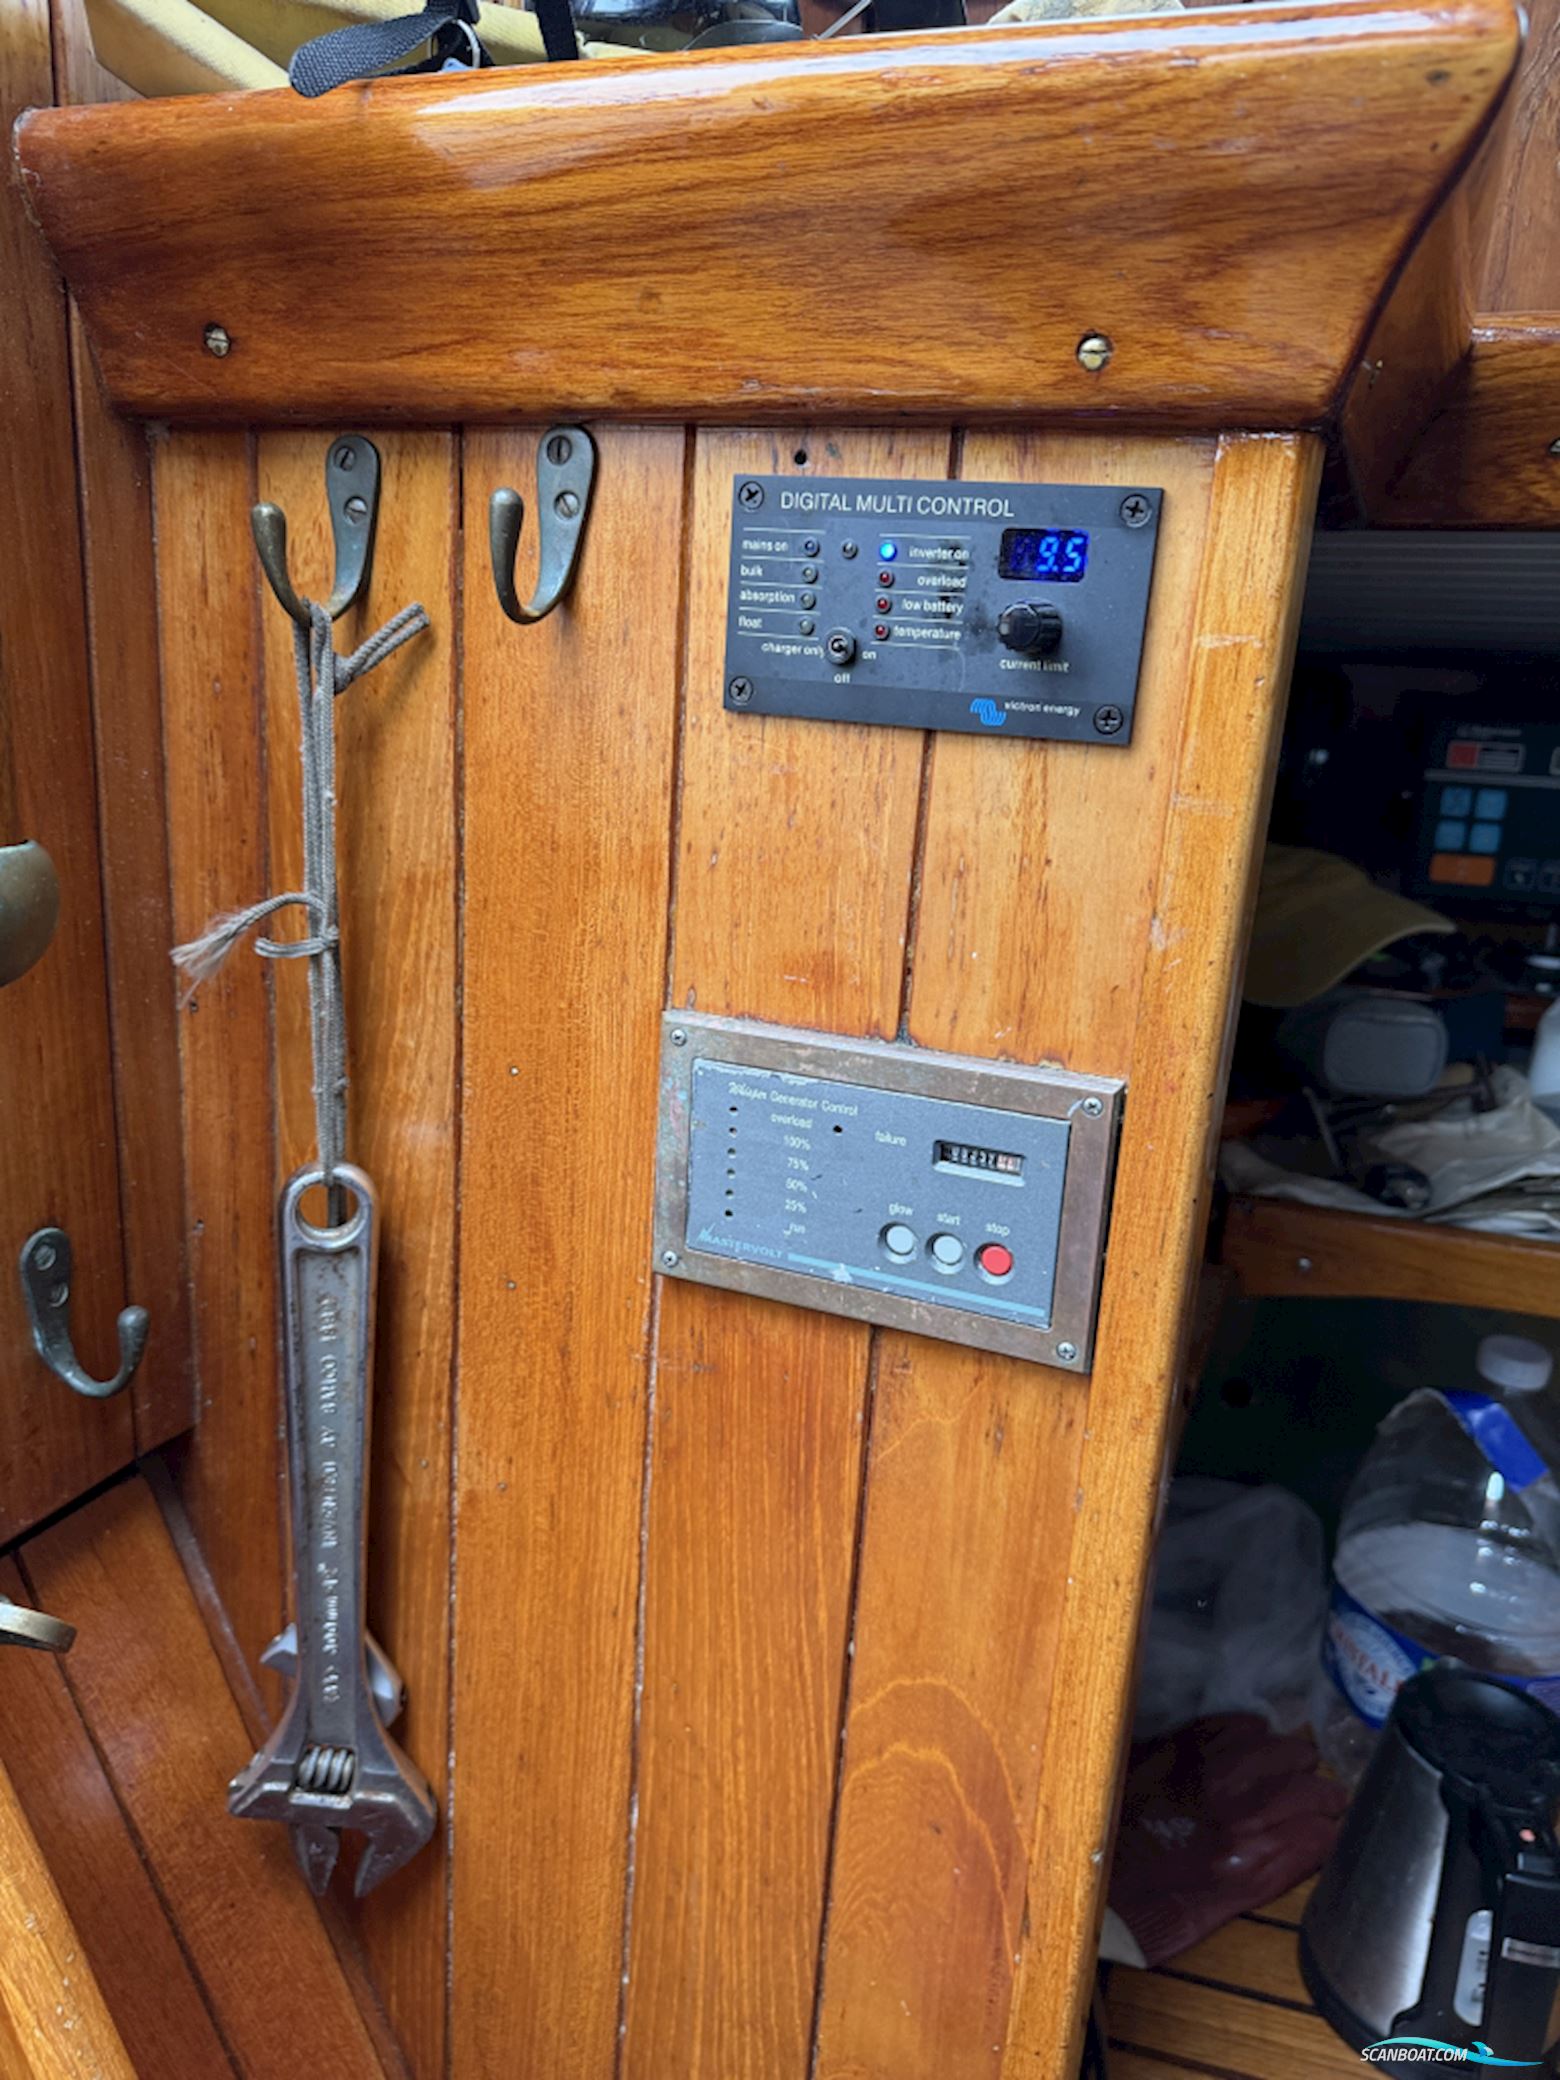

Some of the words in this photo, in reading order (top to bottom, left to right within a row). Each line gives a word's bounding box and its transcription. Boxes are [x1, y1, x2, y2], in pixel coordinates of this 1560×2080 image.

[780, 491, 852, 512] DIGITAL
[855, 495, 912, 513] MULTI
[916, 496, 1015, 518] CONTROL
[742, 540, 773, 552] mains
[774, 541, 789, 552] on
[908, 546, 953, 560] inverter
[953, 548, 970, 560] on
[740, 564, 763, 577] bulk
[916, 575, 967, 589] overload
[739, 588, 796, 604] absorption
[902, 598, 921, 611] low
[923, 599, 963, 616] battery
[738, 615, 763, 629] float
[893, 624, 962, 640] temperature
[760, 641, 802, 657] charger
[803, 644, 825, 660] only
[862, 650, 877, 660] on
[999, 658, 1042, 671] current
[1042, 660, 1071, 674] limit
[833, 672, 851, 685] off
[1004, 700, 1042, 713] victron
[1043, 703, 1081, 718] energy
[770, 1090, 819, 1110] Generator
[820, 1098, 858, 1117] Control
[769, 1112, 813, 1129] overload
[784, 1134, 811, 1151] 100%
[873, 1130, 908, 1147] failure
[787, 1156, 809, 1171] 75%
[785, 1177, 808, 1193] 50%
[784, 1198, 807, 1214] 25%
[888, 1202, 914, 1217] glow
[937, 1212, 961, 1227] start
[985, 1222, 1011, 1238] stop
[697, 1222, 784, 1259] MASTERVOLT
